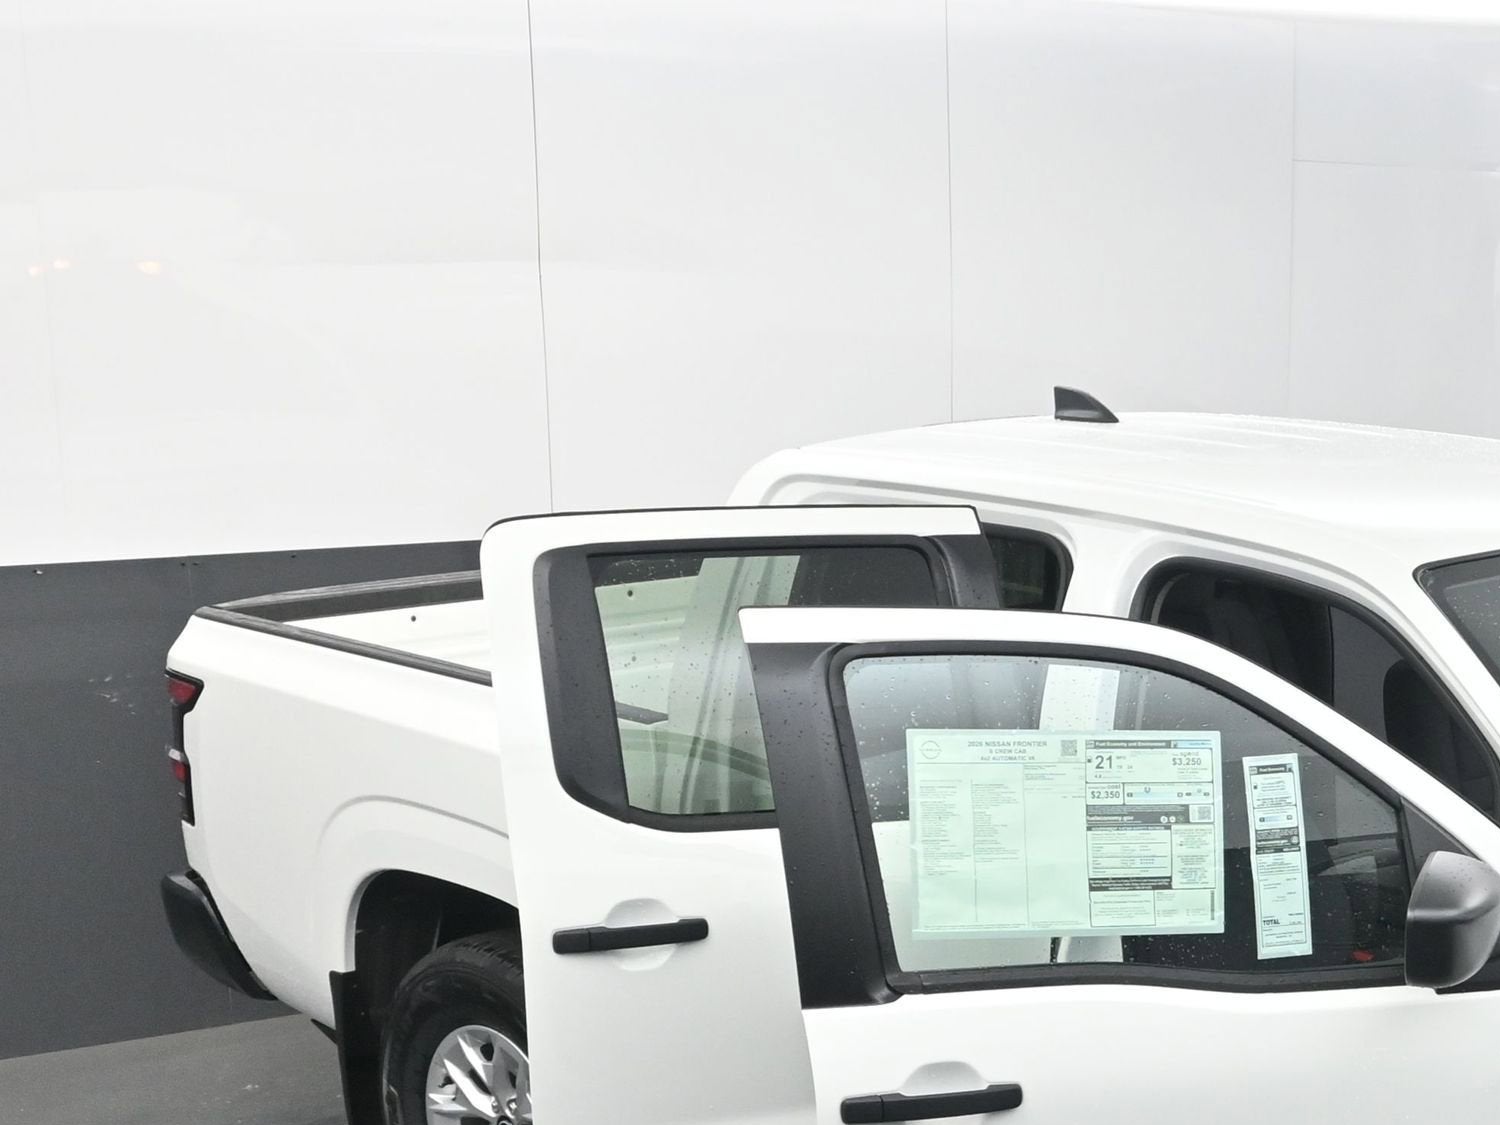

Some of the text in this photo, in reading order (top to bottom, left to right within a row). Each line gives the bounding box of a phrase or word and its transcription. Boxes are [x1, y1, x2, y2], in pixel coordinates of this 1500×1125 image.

[1095, 755, 1113, 769] 21
[1172, 758, 1202, 766] $3,250
[1091, 791, 1121, 799] $2,350
